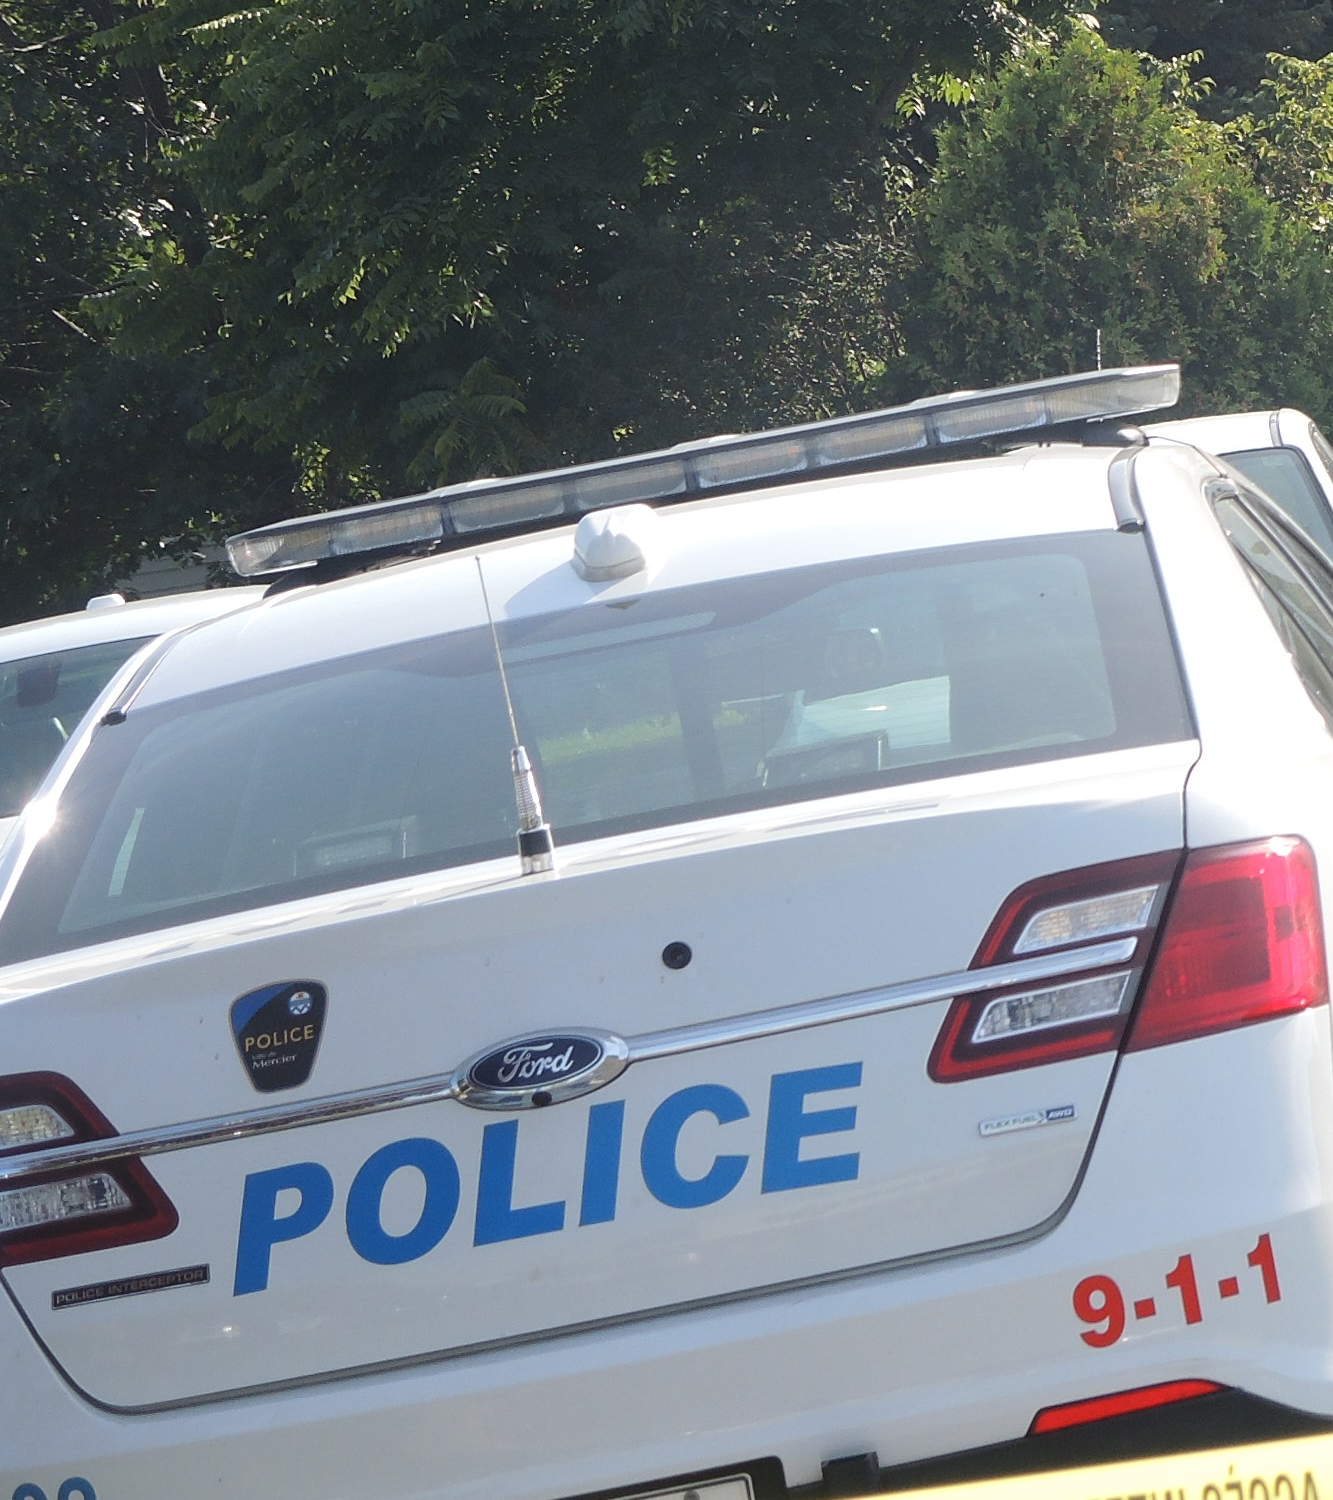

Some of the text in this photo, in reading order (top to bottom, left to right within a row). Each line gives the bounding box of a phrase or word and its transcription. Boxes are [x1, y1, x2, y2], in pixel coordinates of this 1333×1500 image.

[245, 1024, 314, 1052] POLICE
[252, 1053, 298, 1069] Mercier
[497, 1042, 574, 1082] Ford
[233, 1061, 863, 1297] POLICE
[56, 1268, 204, 1305] POLICE INTERCEPTOR
[1072, 1232, 1281, 1348] 9-1-1
